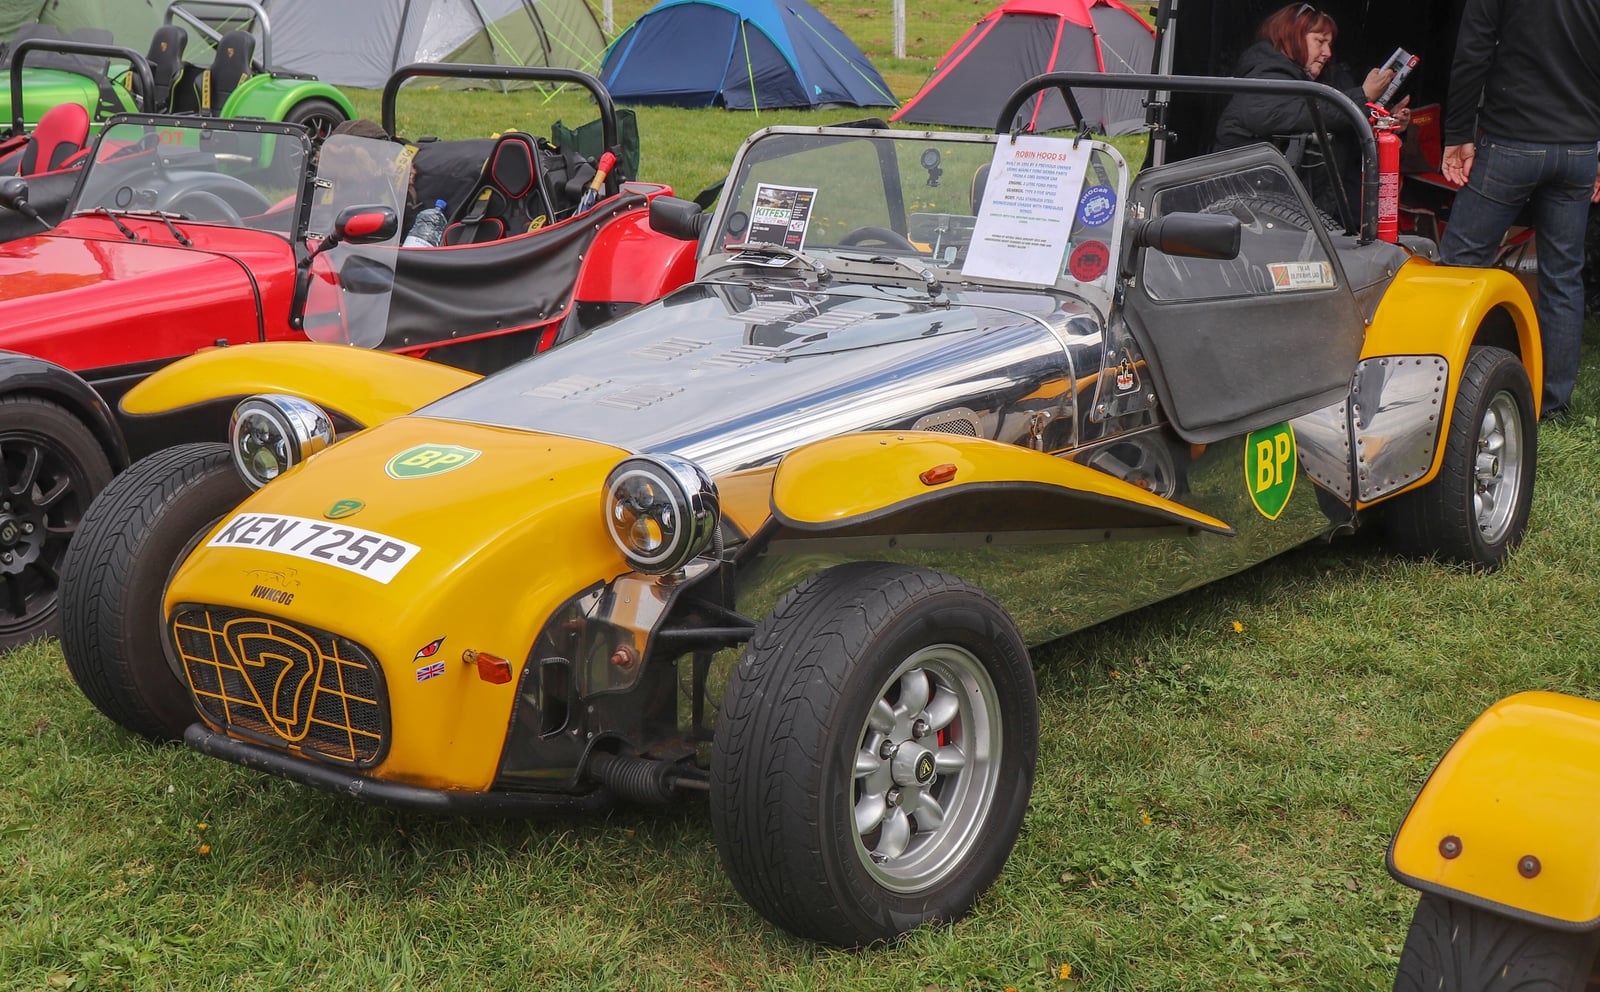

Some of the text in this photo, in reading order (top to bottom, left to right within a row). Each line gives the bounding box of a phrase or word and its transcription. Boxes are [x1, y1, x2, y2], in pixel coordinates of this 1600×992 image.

[1015, 150, 1036, 160] ROBIN
[1037, 152, 1058, 160] HOOD
[755, 207, 791, 218] KITFEST
[399, 450, 466, 469] BP
[1256, 432, 1290, 494] BP
[216, 515, 406, 571] KEN 725P
[251, 585, 294, 606] NWKCOG
[237, 632, 314, 726] 7
